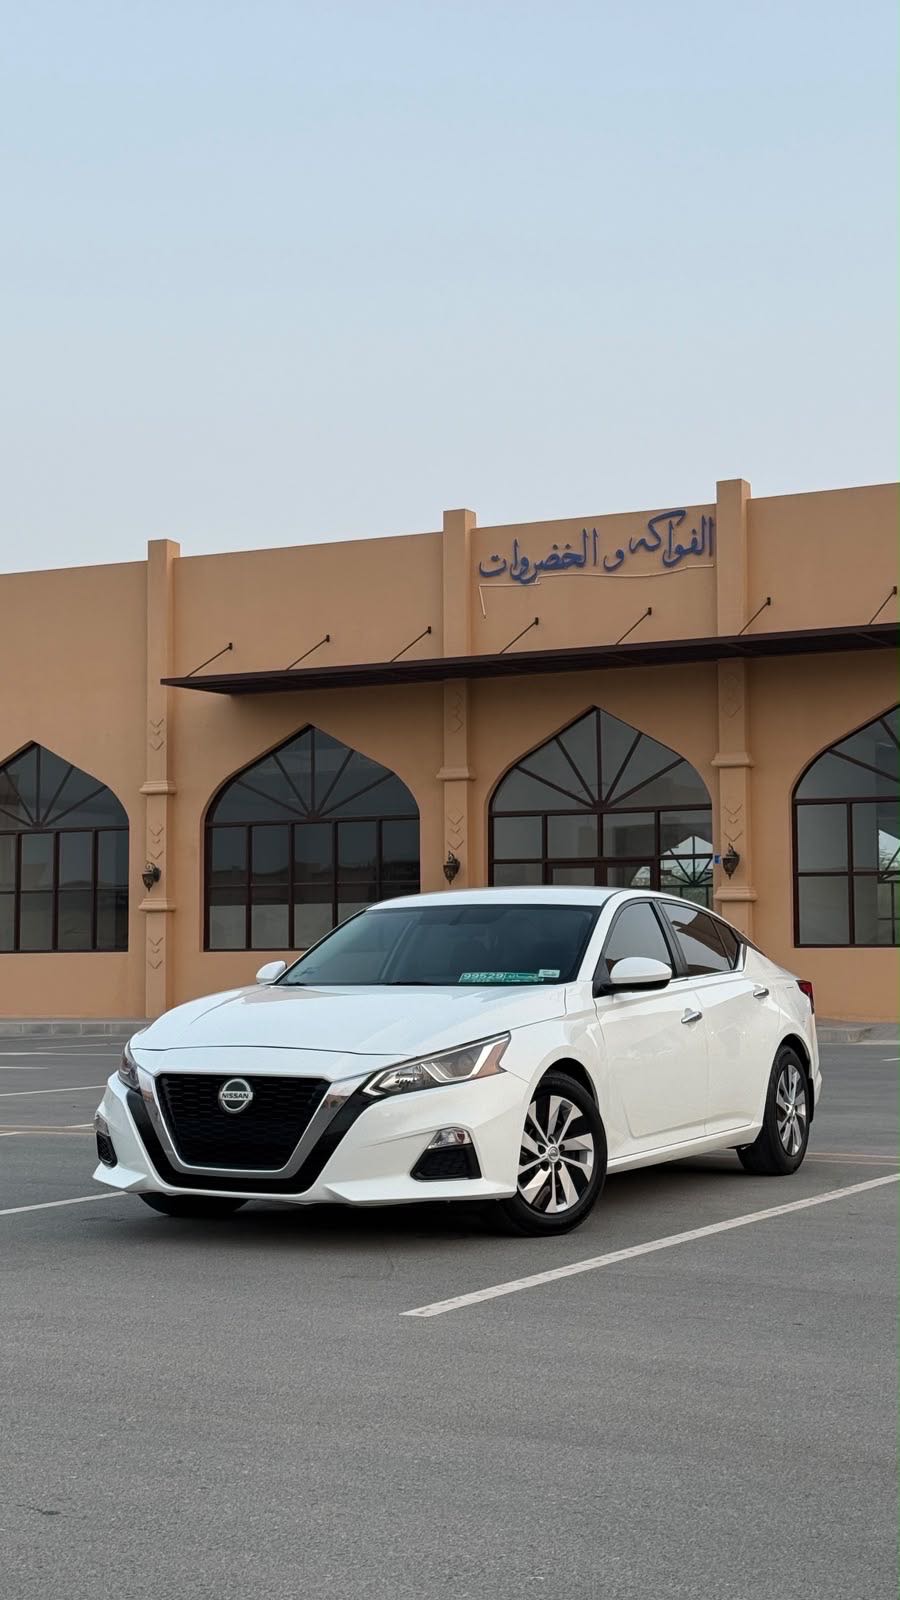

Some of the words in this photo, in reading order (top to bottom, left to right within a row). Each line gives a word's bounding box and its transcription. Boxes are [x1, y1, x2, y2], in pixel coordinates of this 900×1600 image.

[479, 528, 599, 584] الخضروات
[603, 548, 625, 572] و
[629, 509, 715, 567] الفواكه
